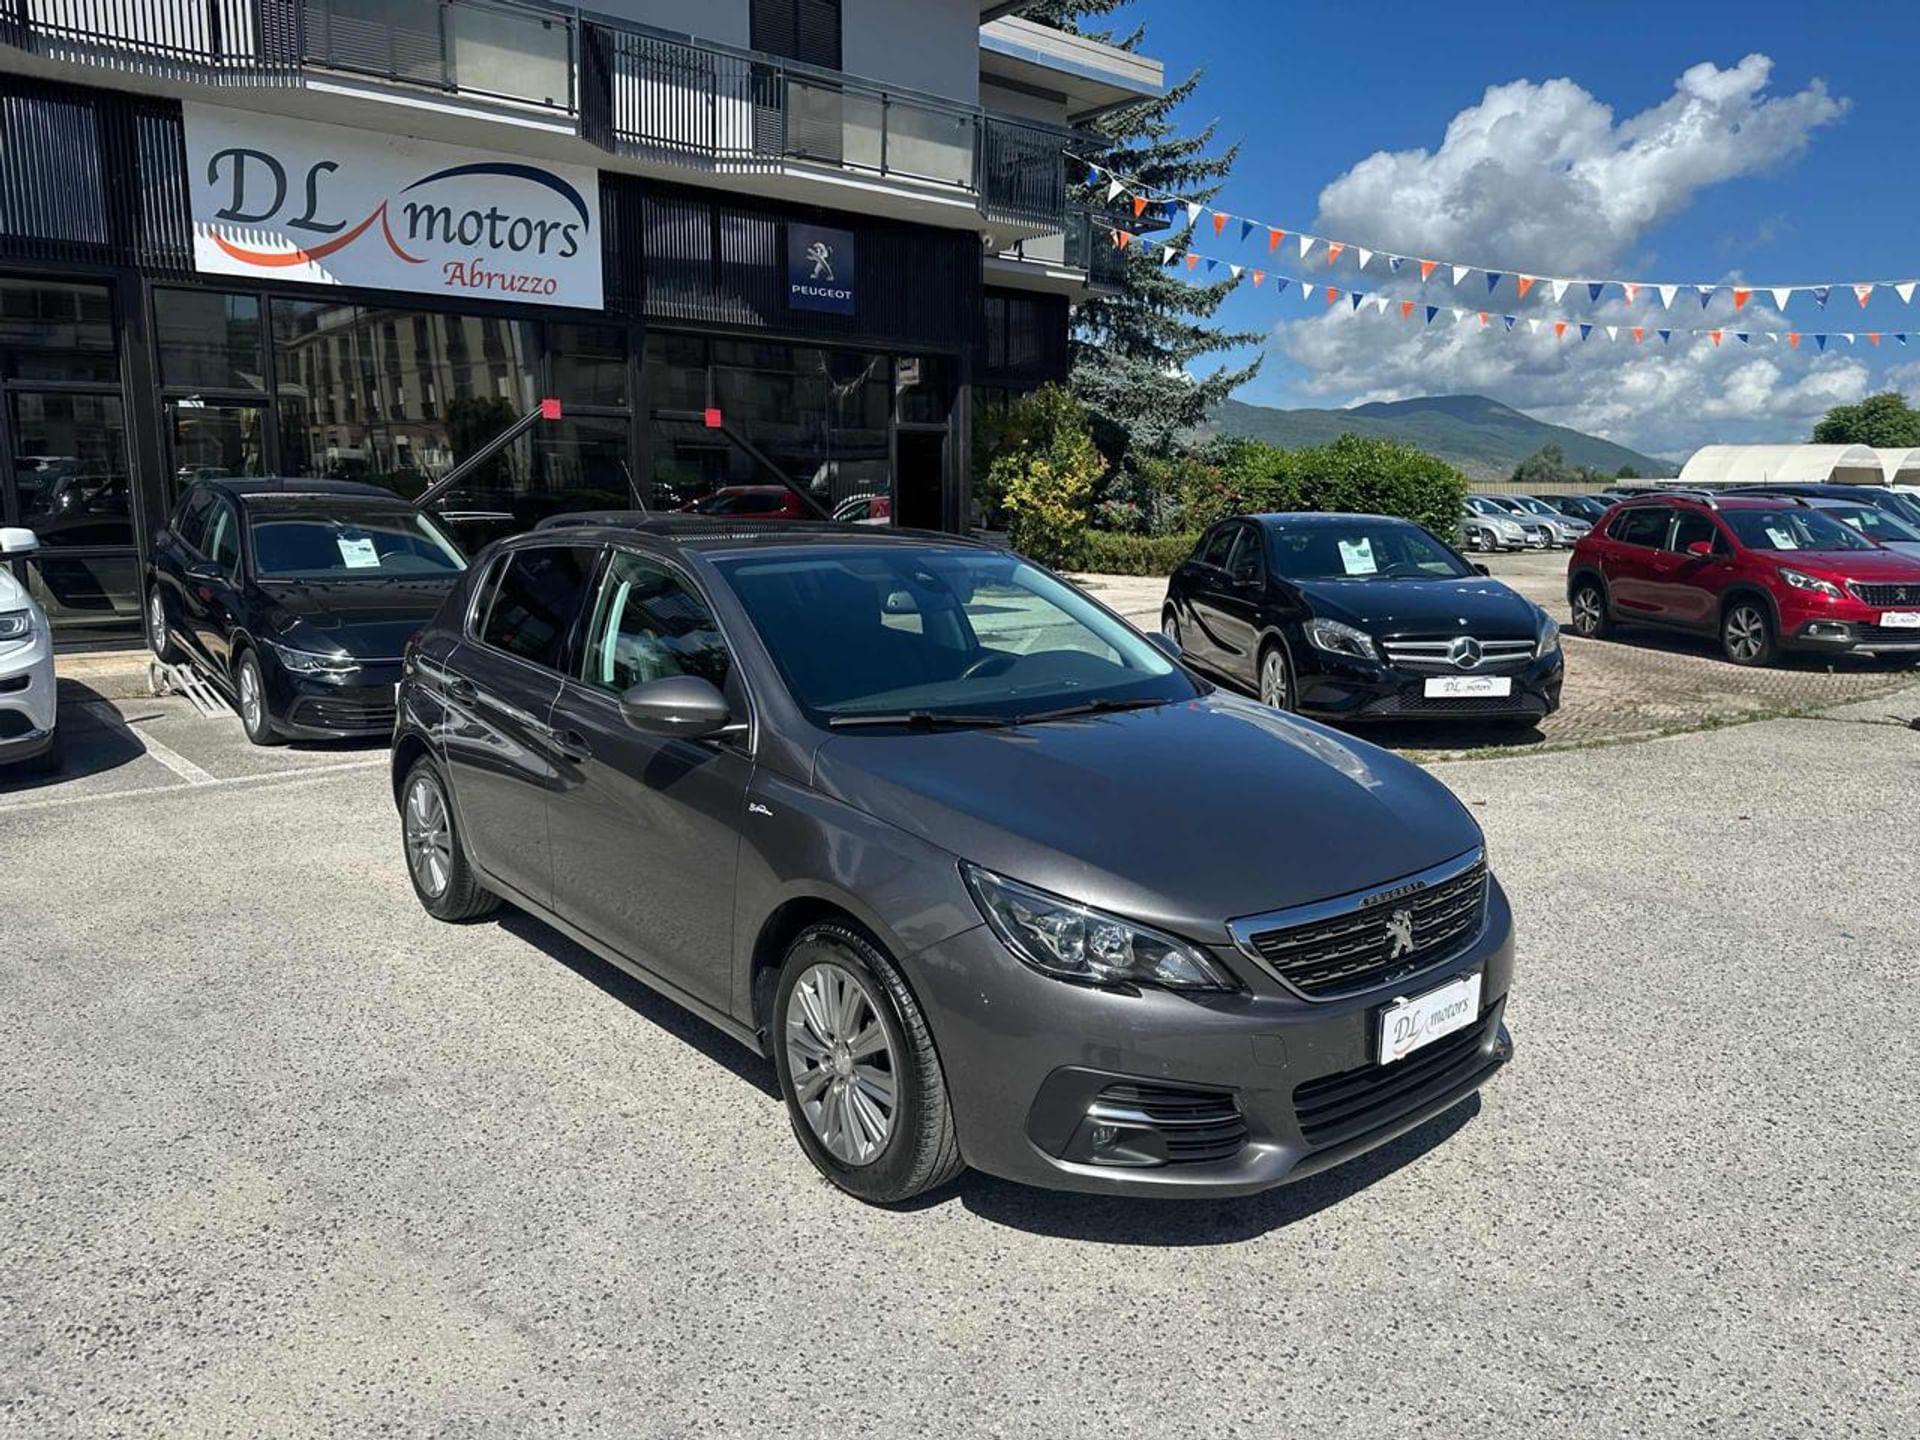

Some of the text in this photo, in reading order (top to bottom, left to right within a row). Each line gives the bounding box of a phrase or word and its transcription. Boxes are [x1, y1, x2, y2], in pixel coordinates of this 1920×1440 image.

[207, 148, 580, 258] DL motors
[443, 258, 558, 295] Abruzzo
[791, 284, 852, 299] PEUGEOT
[1430, 998, 1469, 1026] motors
